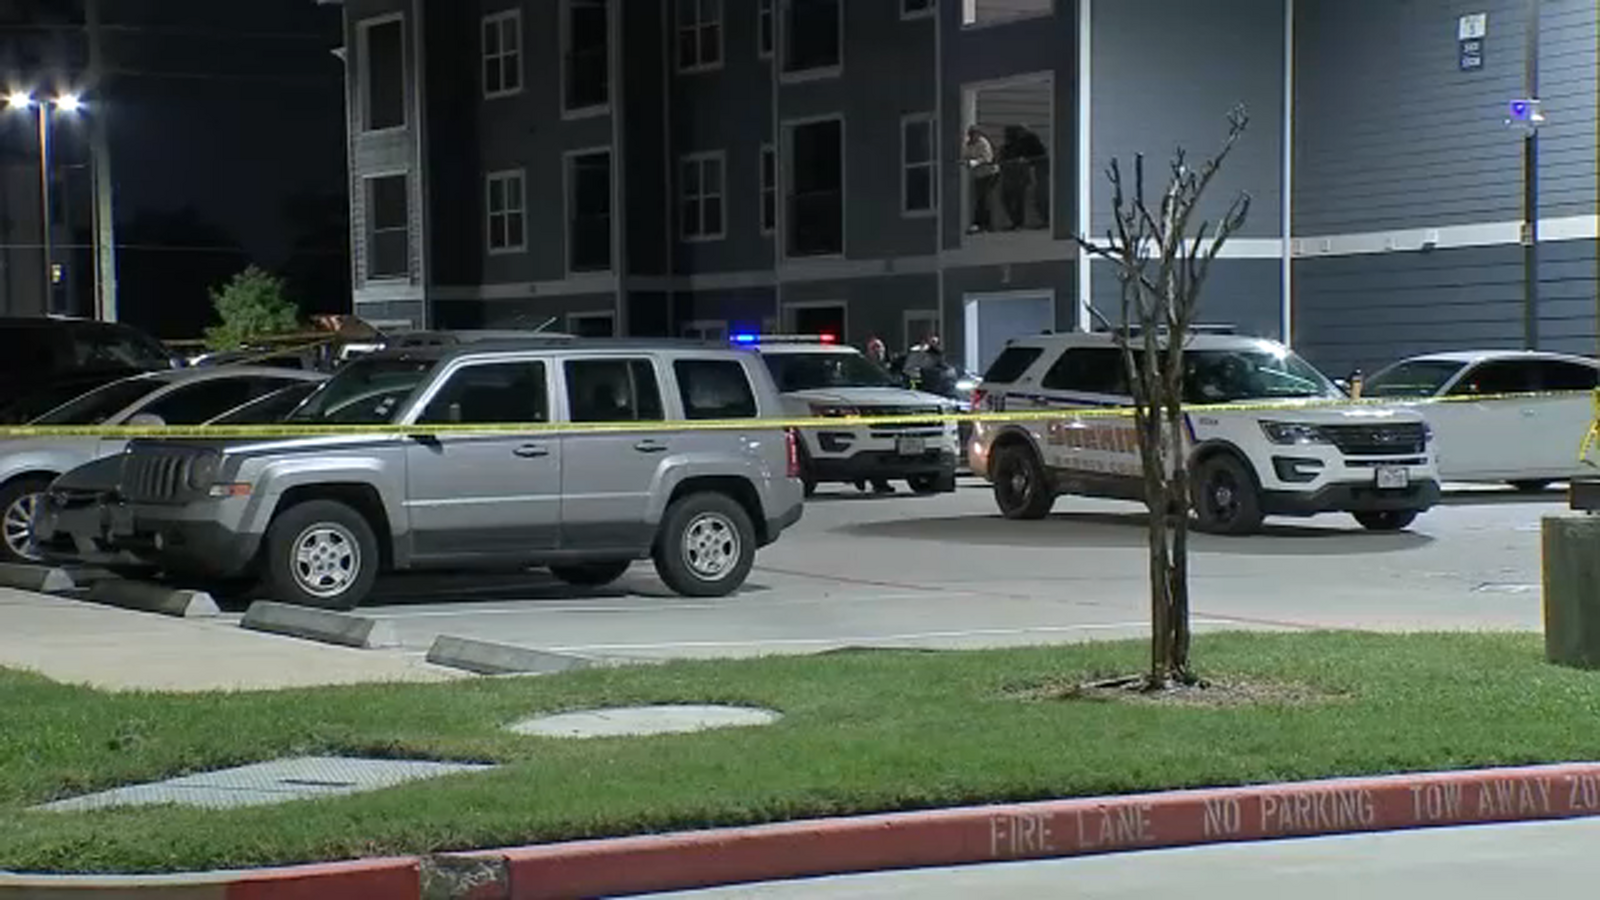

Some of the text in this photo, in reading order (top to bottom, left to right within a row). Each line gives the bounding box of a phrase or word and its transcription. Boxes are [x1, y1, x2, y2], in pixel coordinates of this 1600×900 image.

[989, 773, 1600, 857] FIRE LANE NO PARKING TOW AWAY ZO
